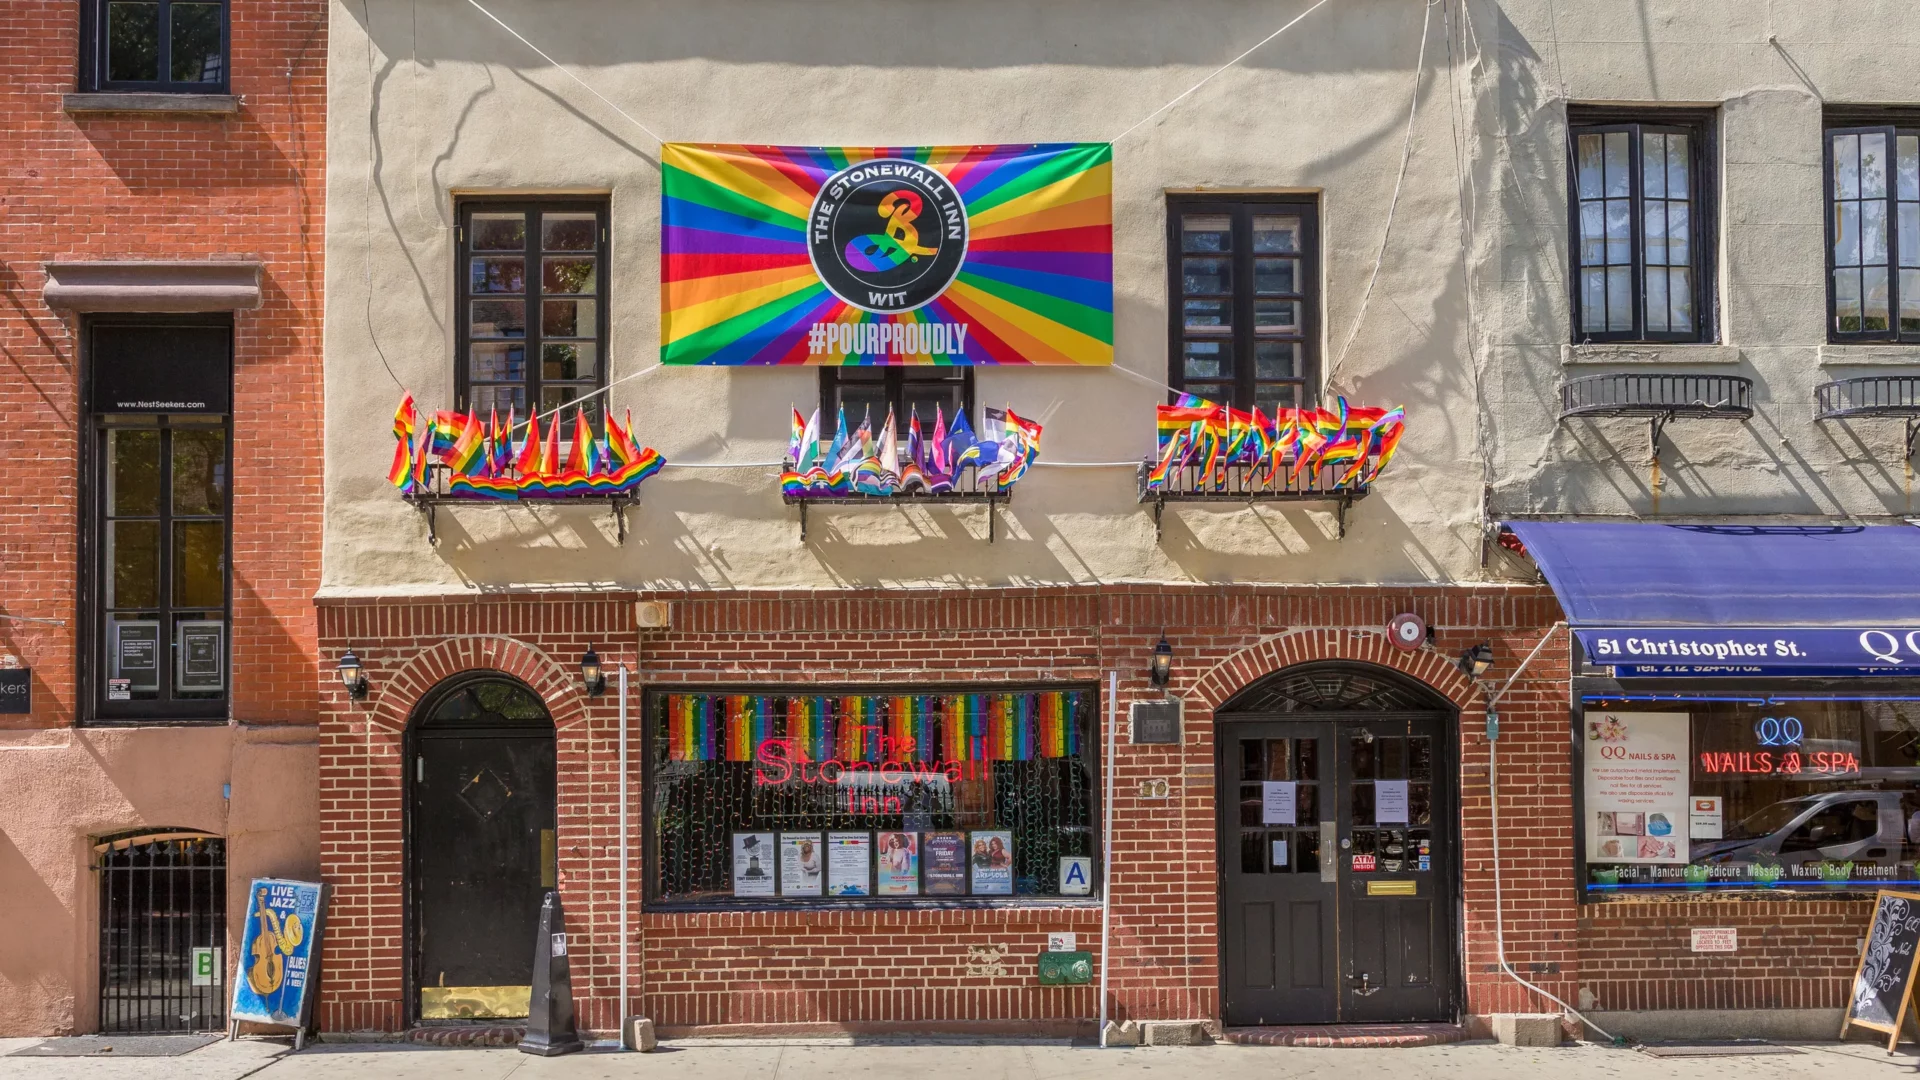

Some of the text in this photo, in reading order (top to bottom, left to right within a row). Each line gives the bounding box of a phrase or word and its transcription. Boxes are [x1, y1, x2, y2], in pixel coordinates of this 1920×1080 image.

[814, 164, 962, 244] THE STONEWALL INN
[868, 291, 908, 307] WIT
[808, 322, 968, 355] #POURPROUDLY
[1597, 637, 1807, 660] 51 Christopher St.
[0, 682, 27, 694] kers
[851, 725, 917, 753] The
[1758, 716, 1804, 746] QQ
[756, 735, 988, 786] Stonewall
[1600, 745, 1626, 760] QQ
[1704, 752, 1773, 773] NAILS
[1816, 752, 1860, 773] SPA
[848, 786, 902, 815] Inn
[1353, 855, 1375, 863] ATM
[1065, 861, 1086, 885] A
[1614, 865, 1640, 878] Facial
[1650, 865, 1689, 878] Manicure
[1693, 865, 1699, 877] &
[1703, 864, 1741, 877] Pedicure
[1747, 864, 1787, 879] Massage,
[1791, 864, 1825, 879] Waxing,
[1829, 864, 1851, 878] Body
[1856, 863, 1898, 877] treatment
[270, 885, 294, 897] LIVE
[269, 897, 296, 909] JAZZ
[280, 910, 286, 919] &
[199, 952, 213, 975] B
[288, 956, 306, 969] BLUES
